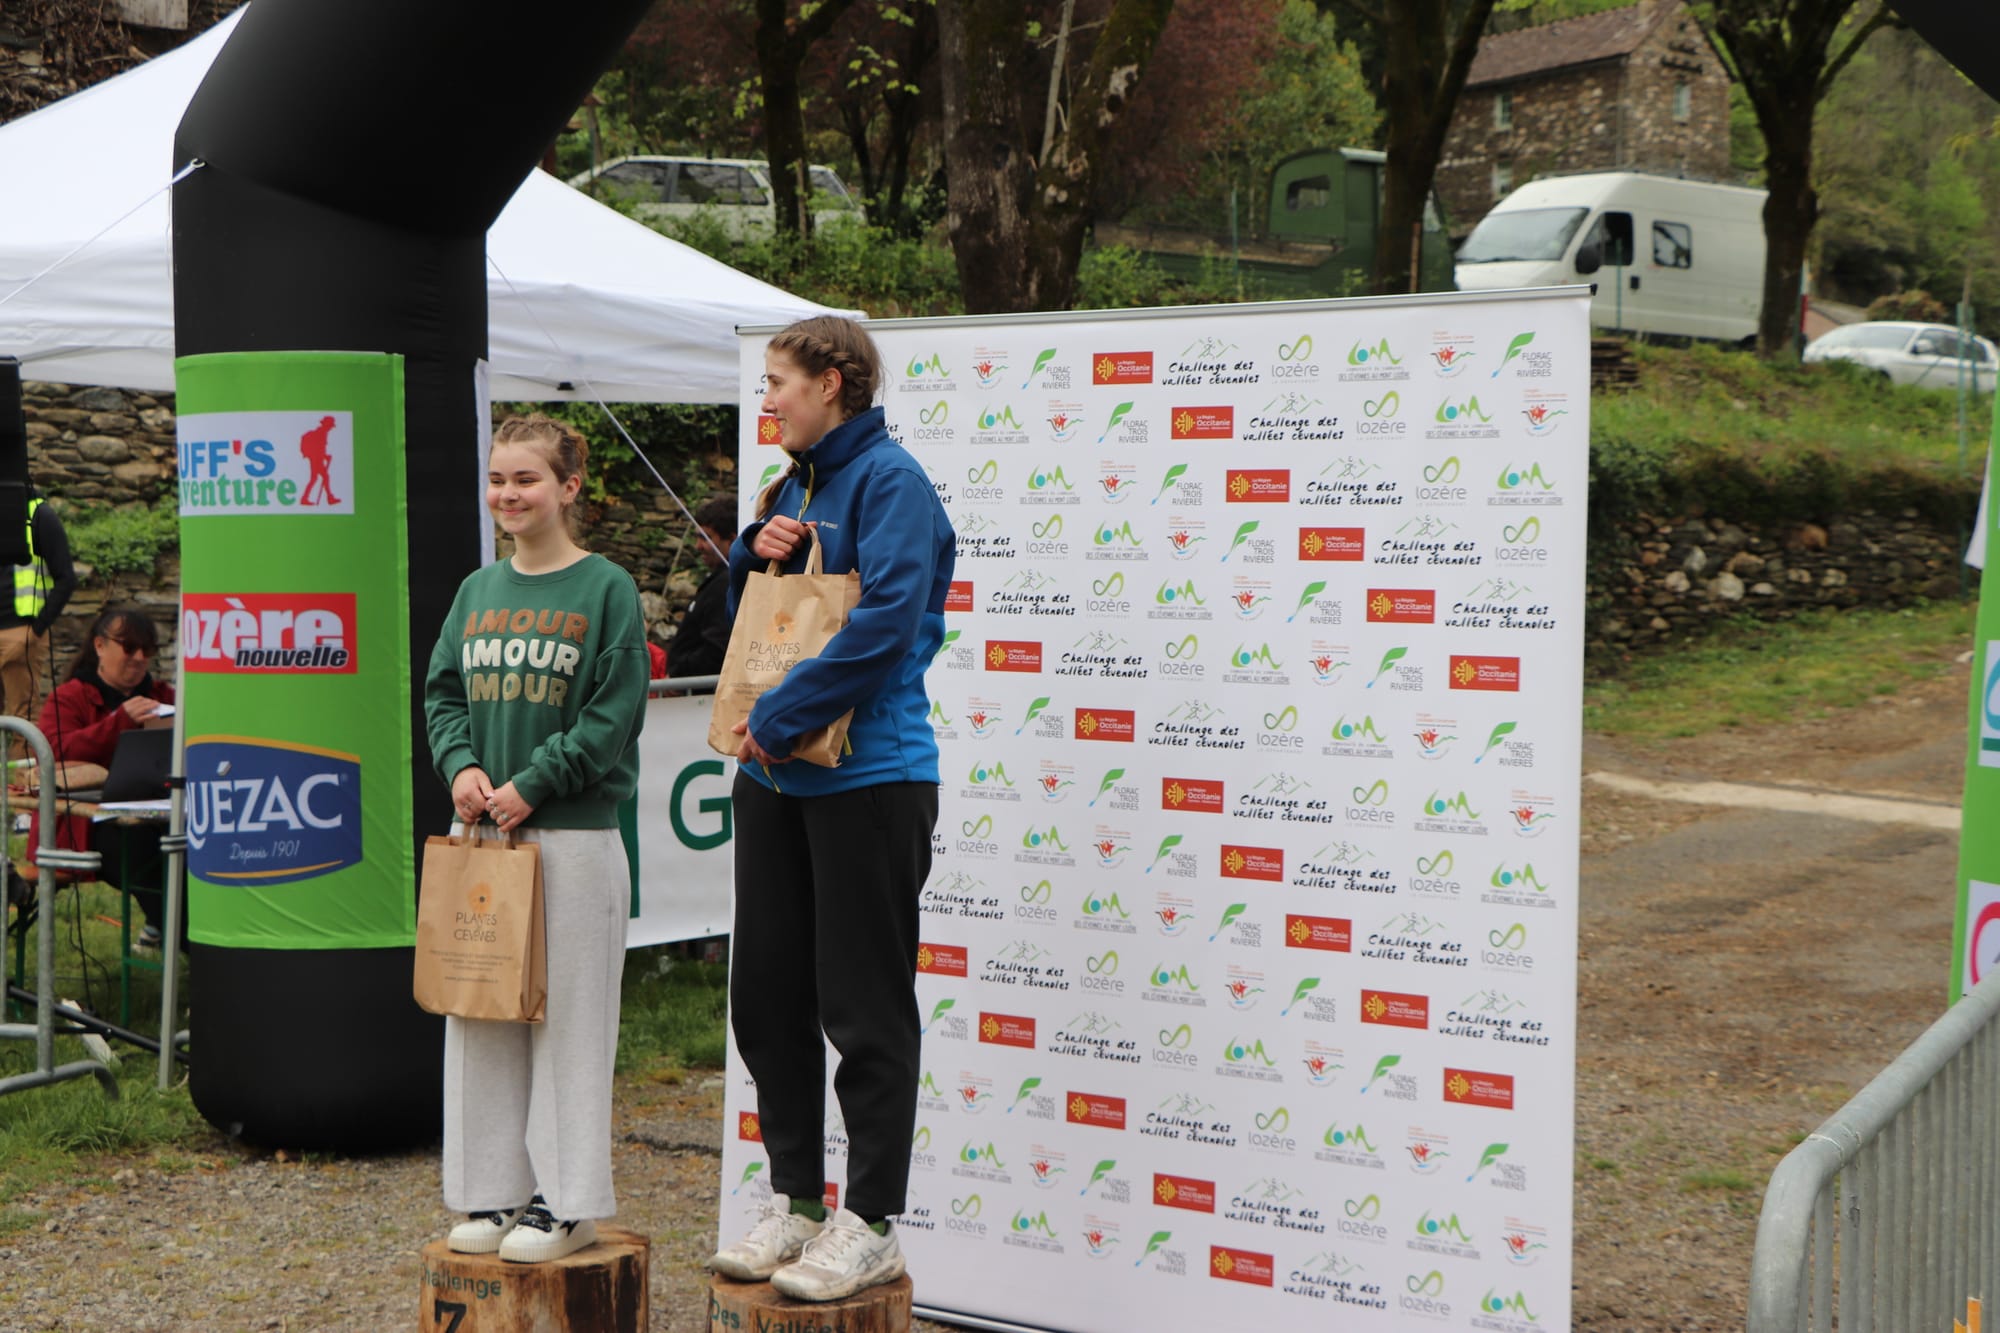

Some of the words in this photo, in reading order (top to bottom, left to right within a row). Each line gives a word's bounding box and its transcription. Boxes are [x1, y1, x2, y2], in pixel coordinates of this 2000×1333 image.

[1118, 363, 1150, 375] Occitanie
[1169, 363, 1226, 372] Challenge
[1234, 361, 1253, 370] des
[1272, 363, 1319, 378] lozère
[1163, 374, 1202, 385] vallées
[1197, 420, 1230, 430] Occitanie
[1250, 418, 1309, 431] Challenge
[1318, 418, 1337, 426] des
[1356, 420, 1406, 434] lozère
[914, 426, 954, 440] lozère
[1244, 430, 1284, 440] vallées
[179, 439, 276, 479] UFF'S
[179, 473, 297, 506] venture
[962, 486, 1003, 499] lozère
[1252, 483, 1287, 493] Occitanie
[1307, 482, 1367, 496] Challenge
[1376, 482, 1396, 491] des
[1416, 486, 1466, 500] lozère
[1300, 494, 1342, 505] vallées
[956, 536, 986, 549] llenge
[993, 537, 1010, 545] des
[1026, 541, 1068, 554] lozère
[1326, 539, 1361, 551] Occitanie
[1382, 540, 1444, 555] Challenge
[1454, 542, 1474, 551] des
[1375, 554, 1418, 564] vallées
[1496, 546, 1547, 560] lozère
[993, 592, 1044, 606] Challenge
[1052, 594, 1070, 602] des
[1087, 599, 1130, 612] lozère
[987, 604, 1022, 614] vallées
[1453, 603, 1518, 618] Challenge
[1527, 606, 1548, 615] des
[184, 597, 344, 660] ozère
[463, 608, 588, 644] AMOUR
[1446, 619, 1490, 627] vallées
[749, 641, 801, 655] PLANTES
[235, 643, 349, 668] nouvelle
[462, 638, 580, 676] AMOUR
[1008, 654, 1039, 664] Occitanie
[1062, 653, 1116, 668] Challenge
[1124, 654, 1142, 664] des
[1056, 666, 1093, 676] vallées
[1160, 662, 1204, 676] lozère
[1478, 670, 1516, 682] Occitanie
[1100, 722, 1132, 732] Occitanie
[1156, 722, 1212, 736] Challenge
[1220, 725, 1238, 736] des
[1149, 736, 1188, 746] vallées
[1257, 733, 1304, 748] lozère
[1188, 791, 1220, 802] Occitanie
[1240, 795, 1298, 811] Challenge
[1307, 800, 1326, 809] des
[1234, 808, 1274, 819] vallées
[1346, 807, 1394, 822] lozère
[230, 842, 268, 865] Depuis
[271, 839, 301, 857] 1901
[1247, 859, 1280, 870] Occitanie
[1300, 864, 1361, 879] Challenge
[1370, 870, 1390, 879] des
[1294, 877, 1336, 888] vallées
[1410, 878, 1460, 894] lozère
[925, 891, 974, 907] Challenge
[981, 896, 998, 906] des
[1015, 904, 1057, 920] lozère
[1313, 929, 1348, 940] Occitanie
[1369, 934, 1431, 952] Challenge
[1440, 942, 1461, 952] des
[1362, 949, 1404, 960] vallées
[1482, 950, 1533, 968] lozère
